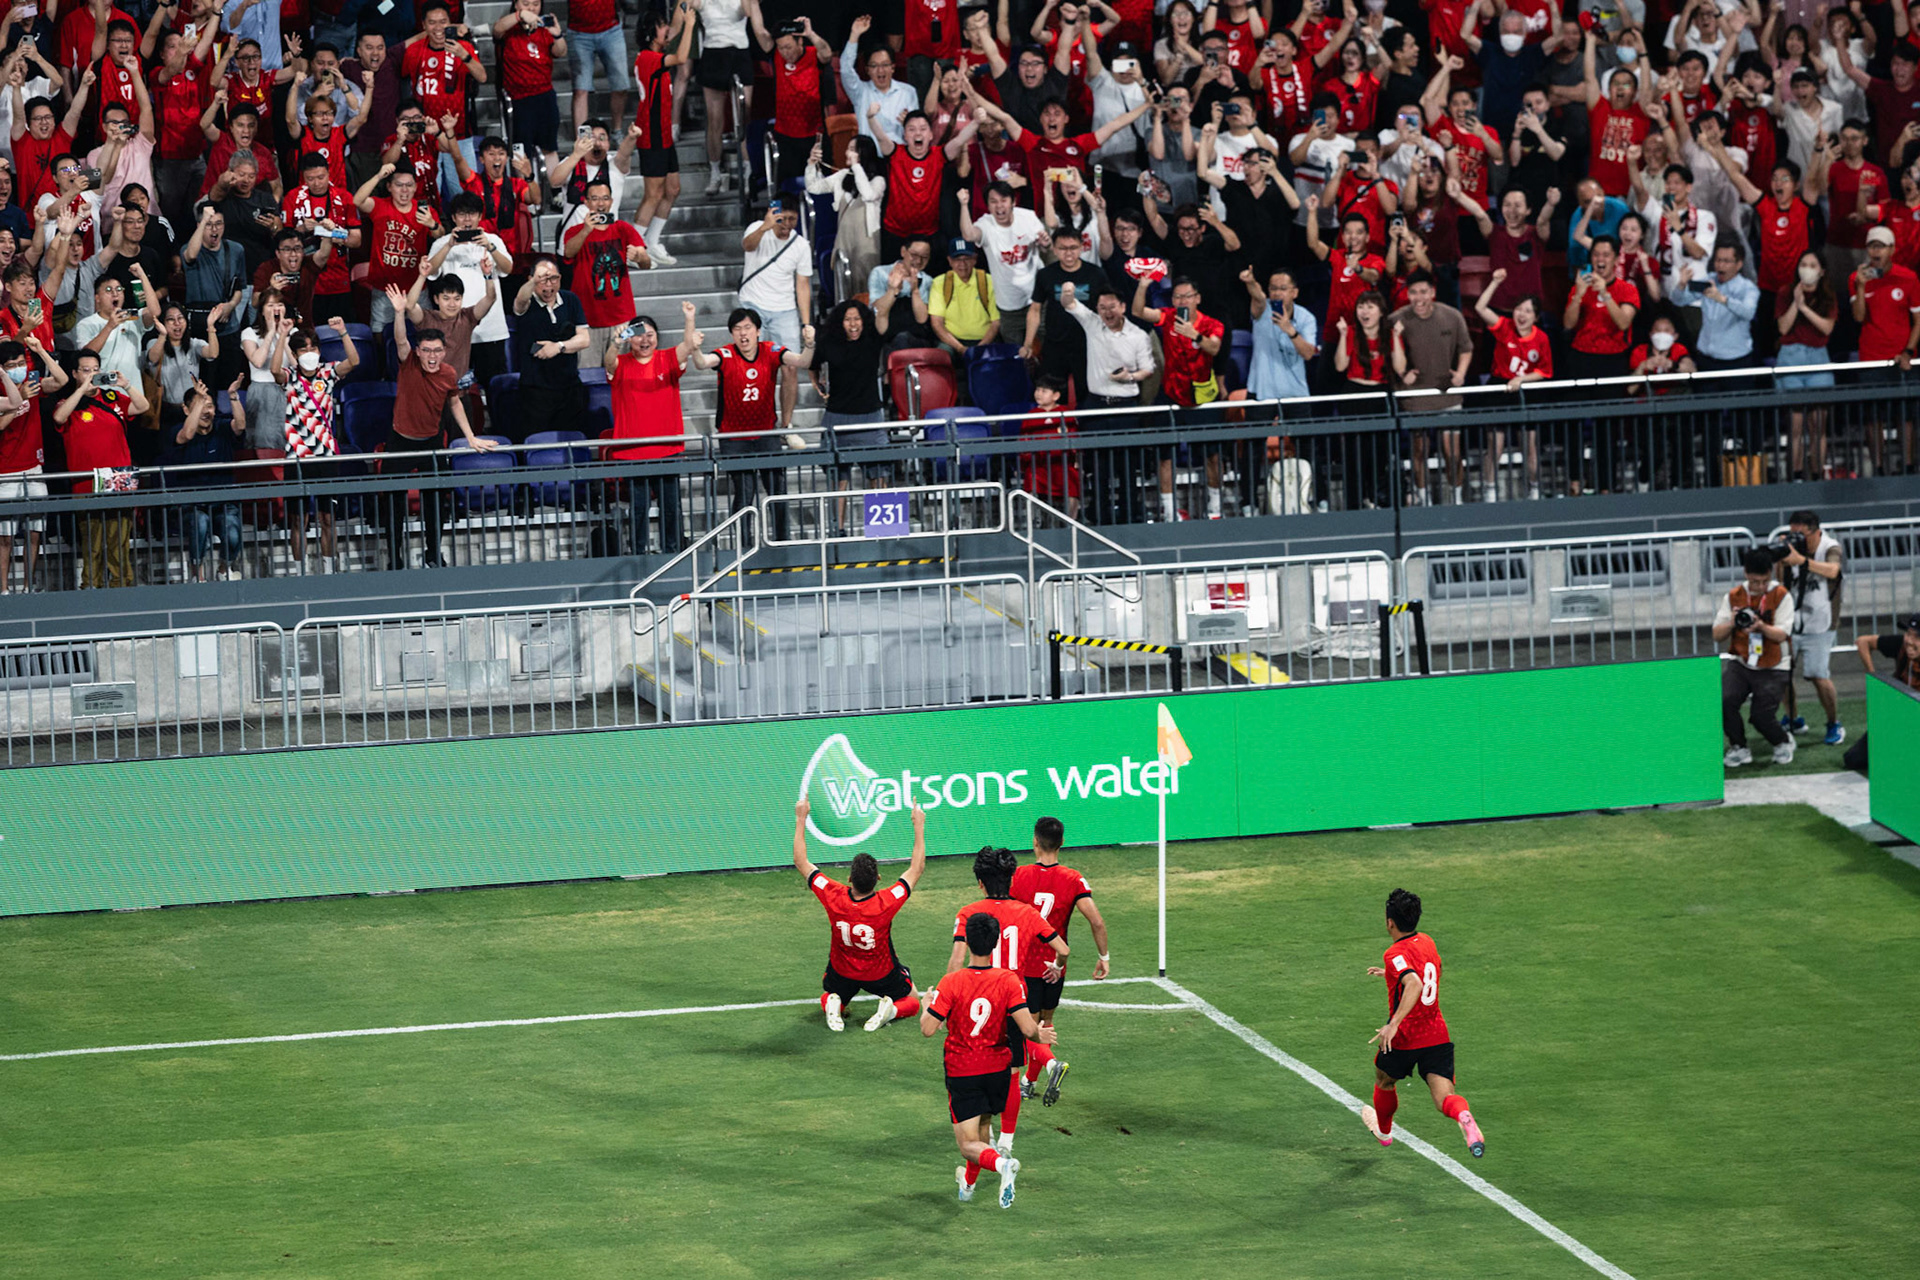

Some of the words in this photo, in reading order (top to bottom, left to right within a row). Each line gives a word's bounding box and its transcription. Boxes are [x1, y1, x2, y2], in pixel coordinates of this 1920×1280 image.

[120, 84, 133, 100] 17
[424, 78, 438, 95] 12
[1600, 147, 1626, 163] BOY
[383, 253, 417, 268] BOYS
[742, 387, 760, 402] 23
[868, 503, 904, 526] 231
[824, 767, 1029, 817] Watsons
[1047, 755, 1190, 802] water
[1033, 892, 1056, 921] 7
[836, 920, 876, 951] 13
[992, 925, 1019, 971] 11
[1420, 961, 1438, 1006] 8
[969, 997, 992, 1038] 9
